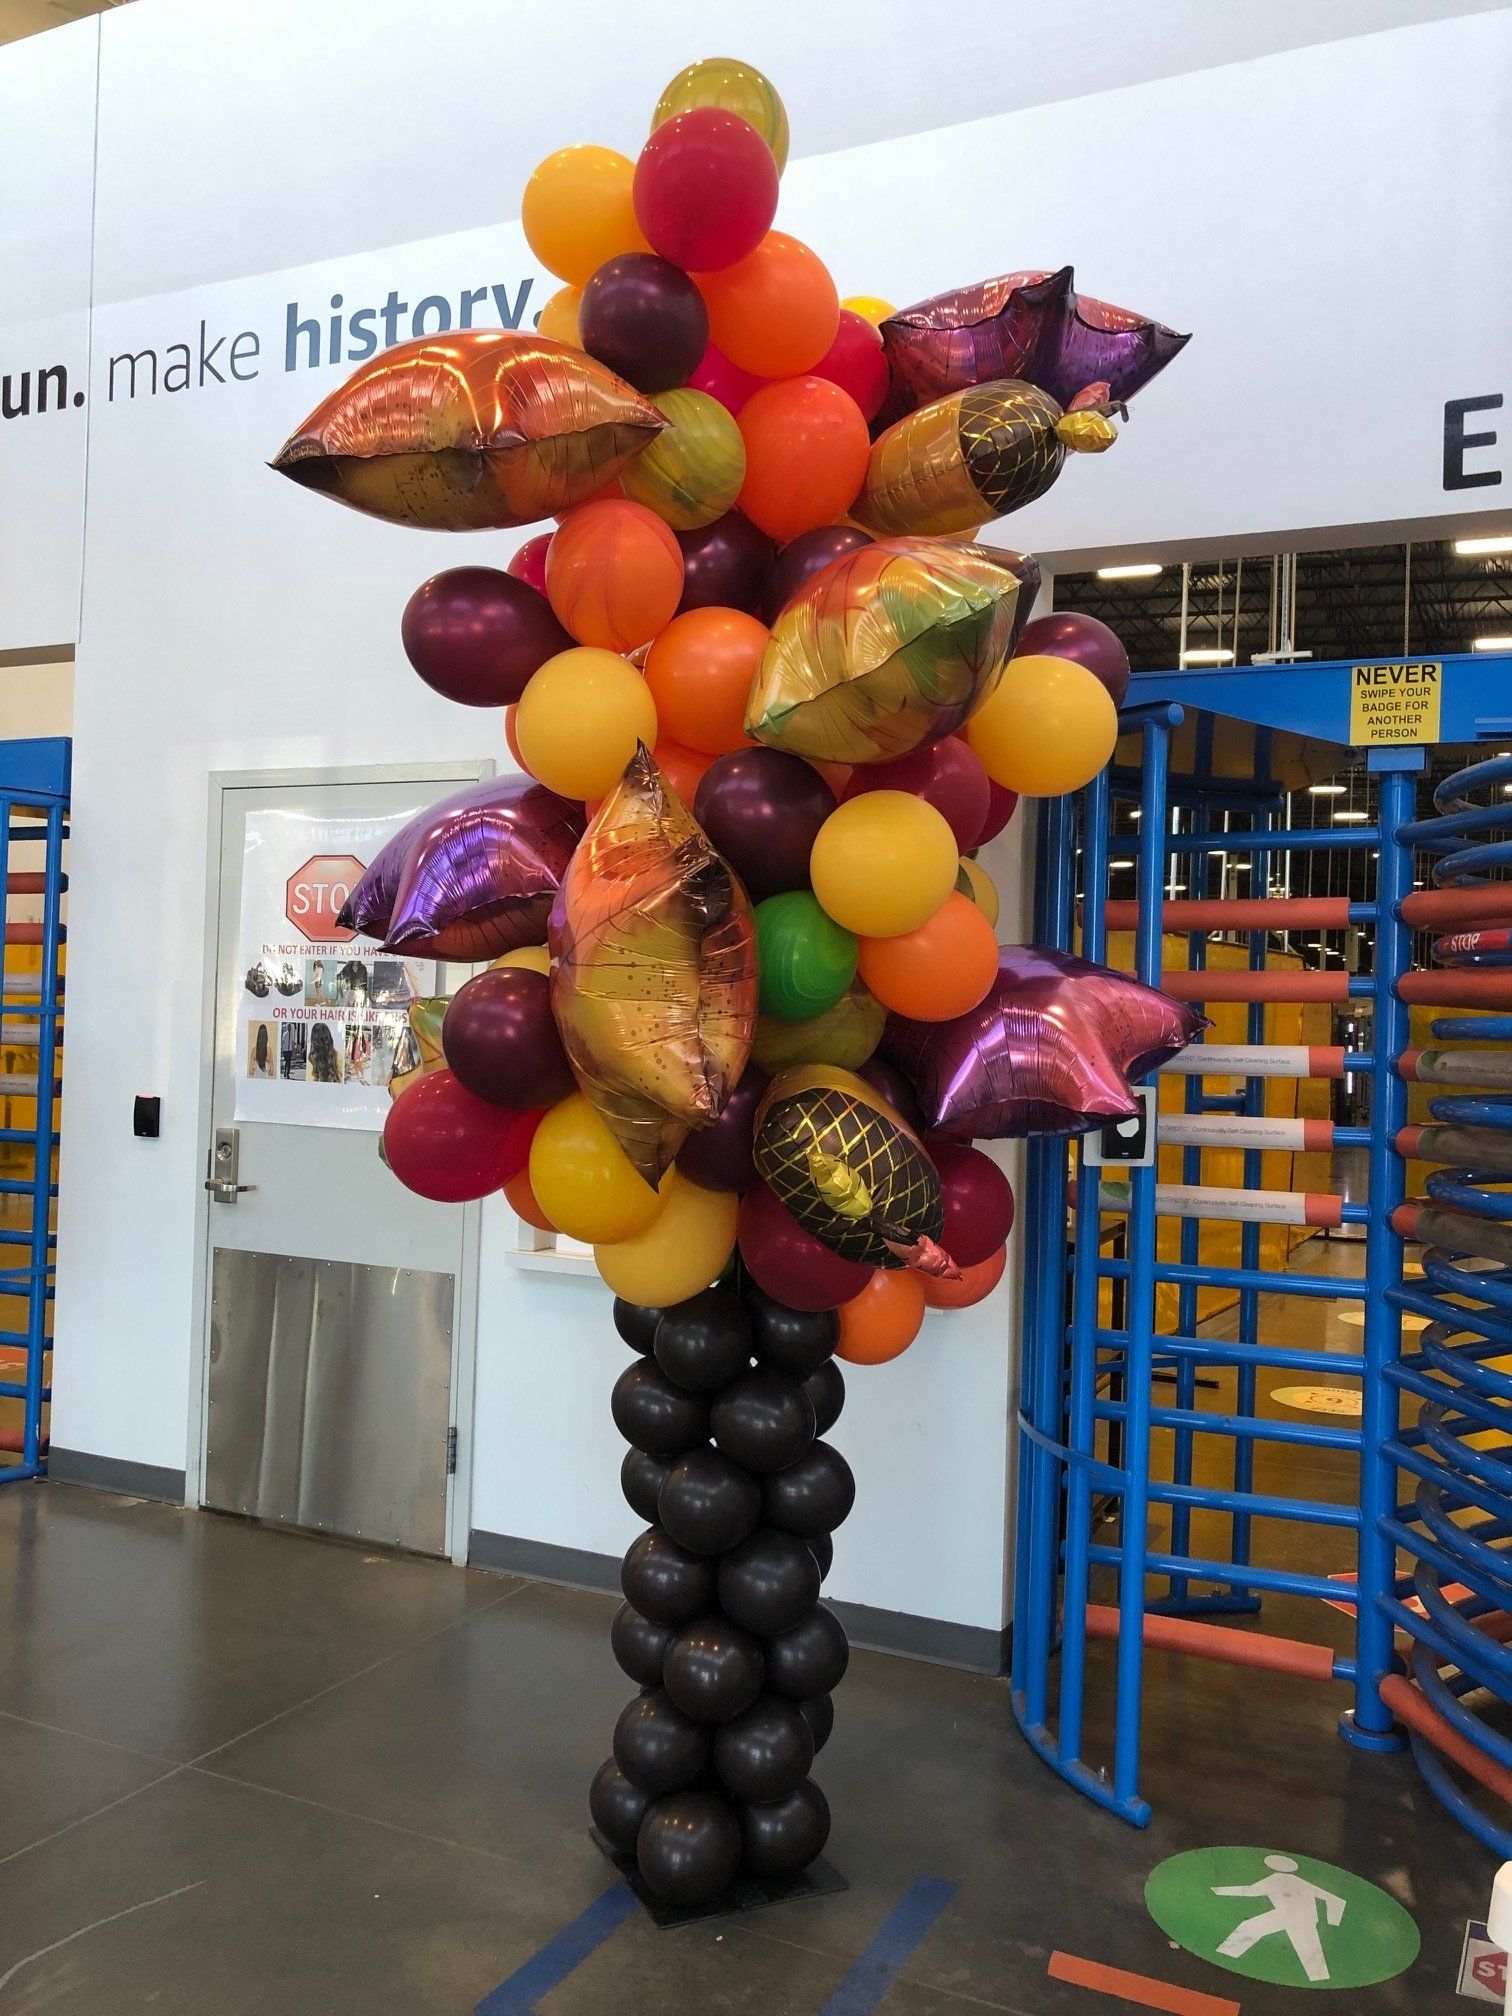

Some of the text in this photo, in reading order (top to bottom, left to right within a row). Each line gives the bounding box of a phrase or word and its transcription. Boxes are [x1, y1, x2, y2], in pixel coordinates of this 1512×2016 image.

[2, 364, 85, 419] un.
[109, 319, 260, 402] make
[1443, 392, 1503, 491] E
[1356, 664, 1437, 686] NEVER
[1360, 687, 1431, 699] SWIPE YOUR
[1362, 700, 1429, 712] BADGE FOR
[1367, 714, 1422, 725] ANOTHER
[1370, 728, 1418, 738] PERSON
[292, 882, 357, 915] STO
[1450, 933, 1481, 952] STOP
[278, 944, 299, 955] NOT
[300, 945, 327, 956] ENTER
[329, 945, 338, 956] IF
[341, 945, 361, 956] YOU
[273, 1007, 288, 1019] OR
[290, 1008, 318, 1020] YOUR
[320, 1009, 345, 1021] HAIR
